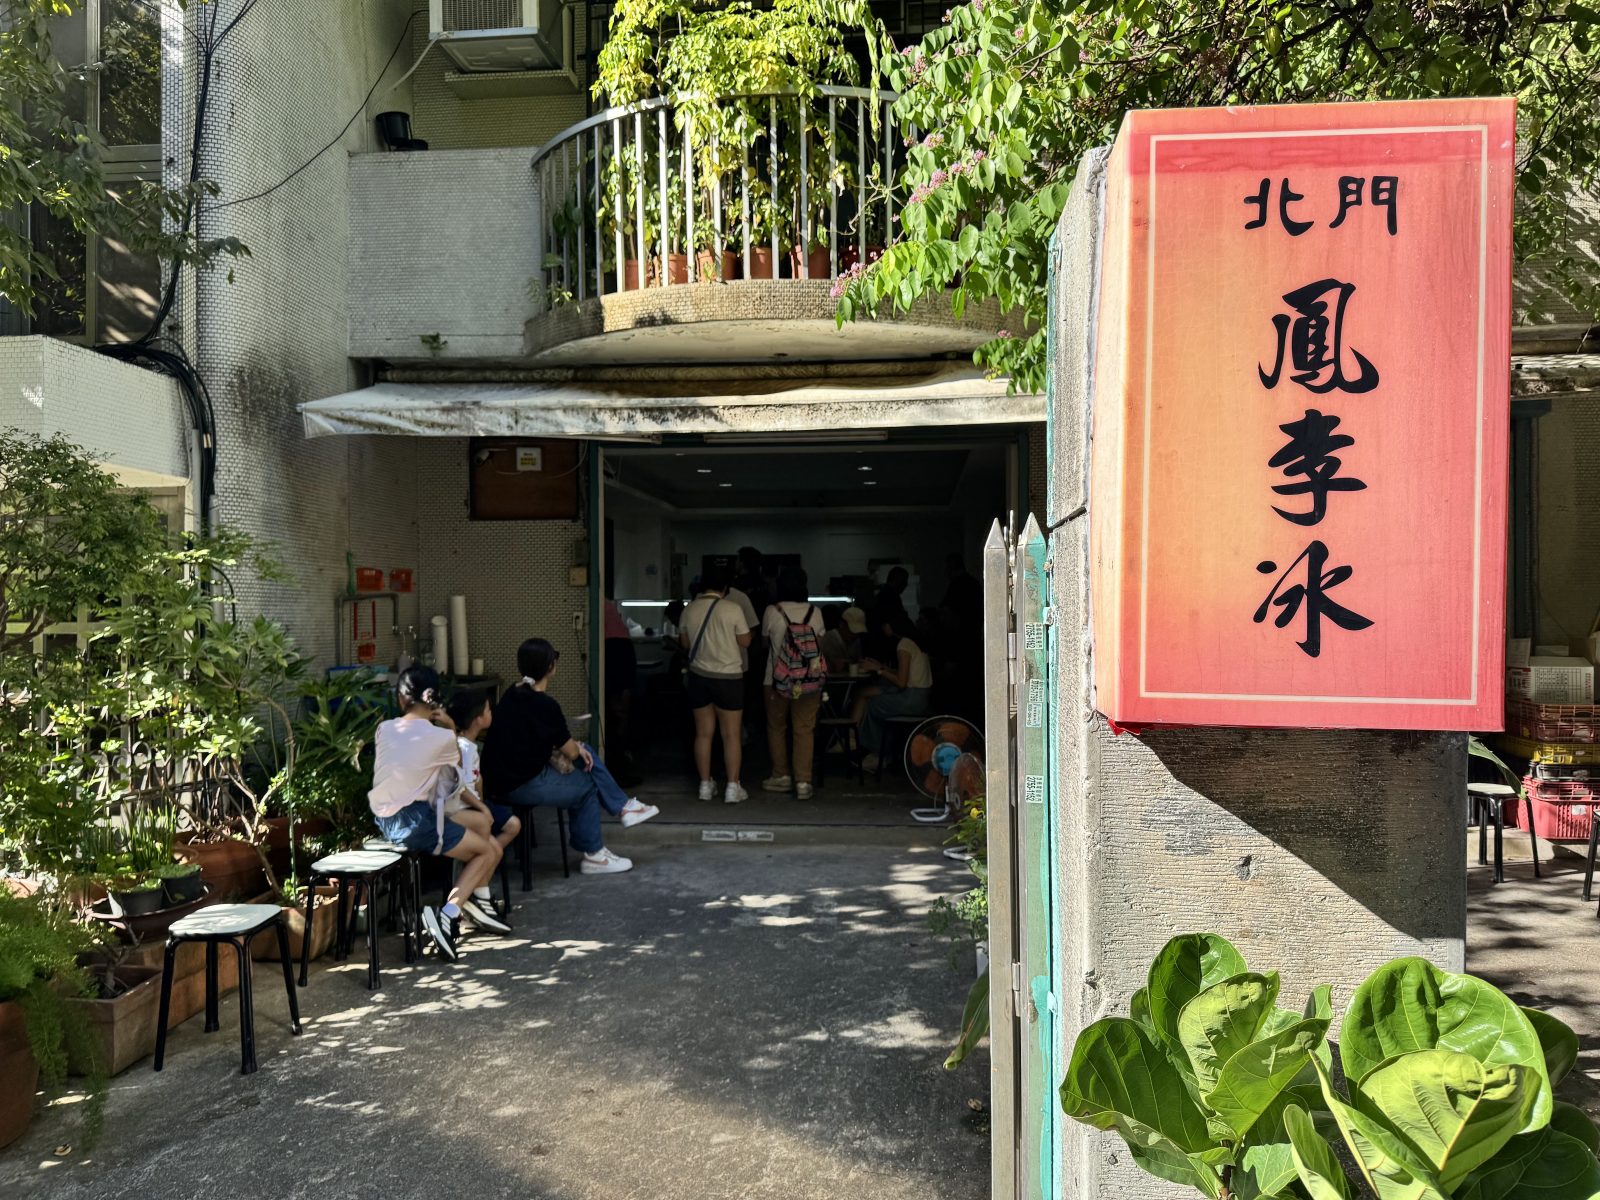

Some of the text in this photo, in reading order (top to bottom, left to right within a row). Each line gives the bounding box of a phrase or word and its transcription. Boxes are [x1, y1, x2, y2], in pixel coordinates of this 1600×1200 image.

[1244, 176, 1399, 237] 北門
[1253, 278, 1380, 658] 鳳李冰
